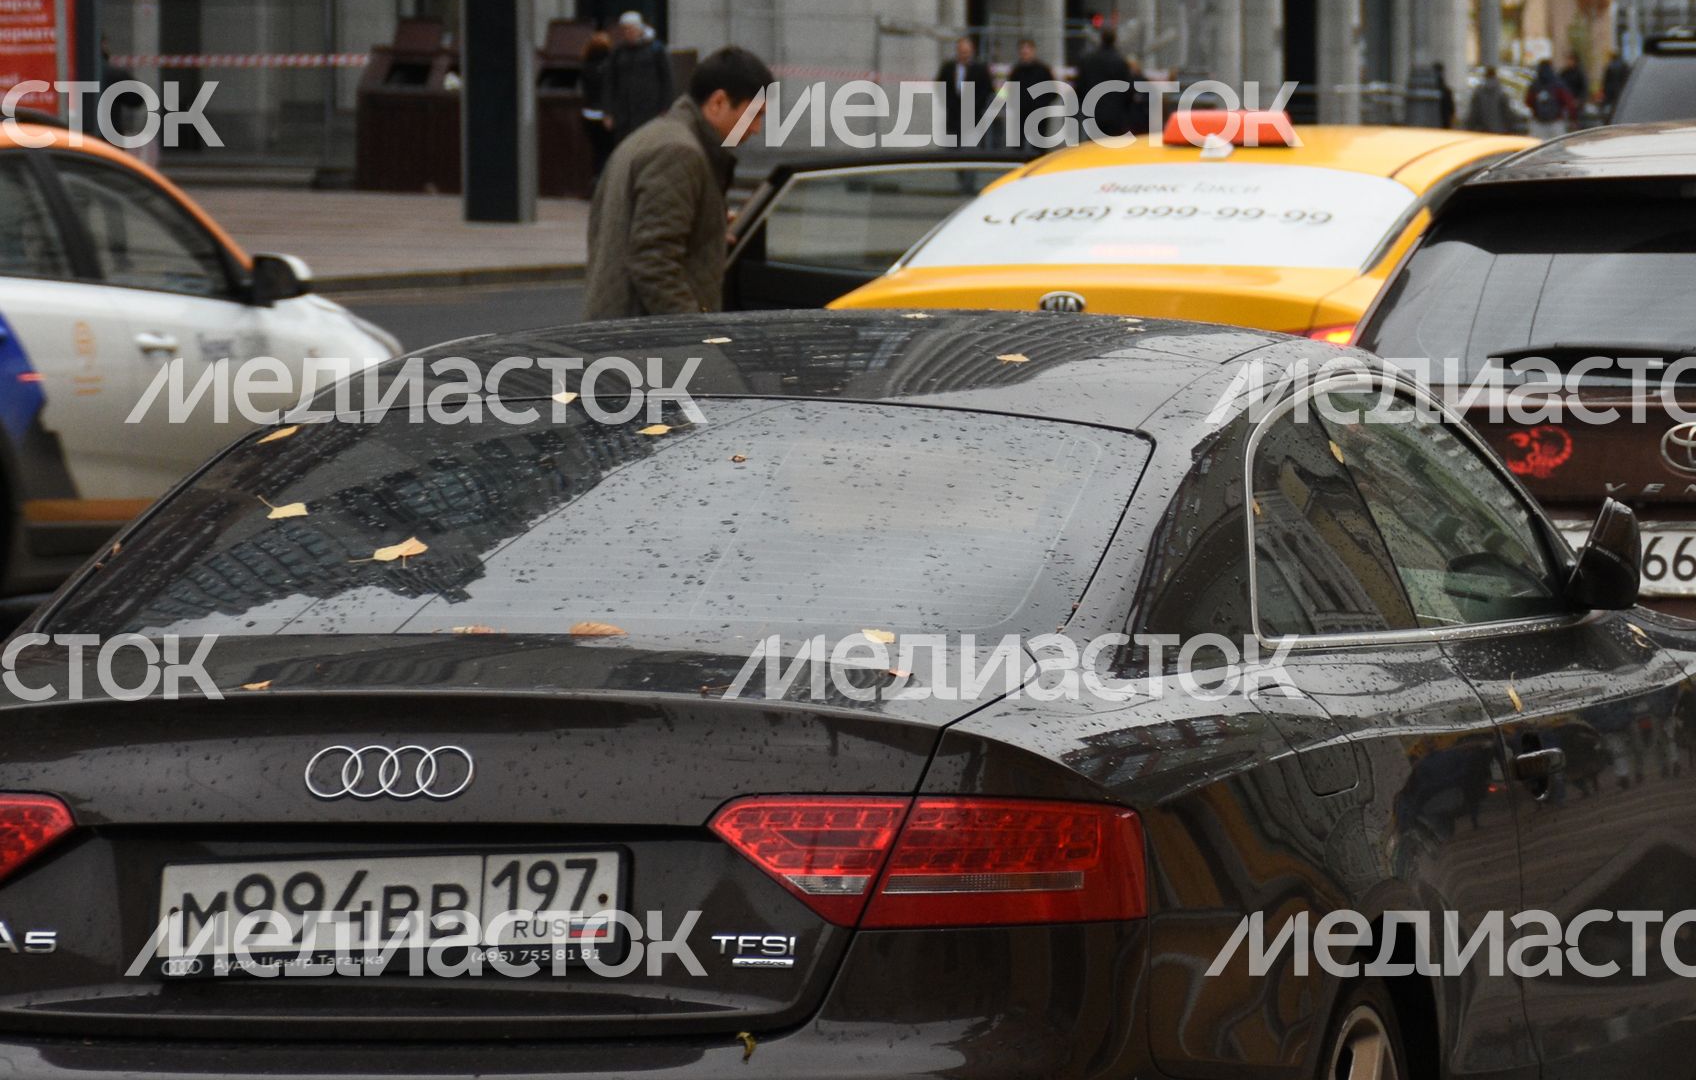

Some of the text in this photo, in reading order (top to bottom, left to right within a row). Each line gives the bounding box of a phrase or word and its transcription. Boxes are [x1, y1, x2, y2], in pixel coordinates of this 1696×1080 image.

[1011, 204, 1334, 227] (495) 999-99-99
[491, 858, 599, 915] 197
[513, 919, 566, 938] RUS
[520, 950, 550, 961] 755
[555, 949, 575, 960] 81
[711, 935, 797, 956] TFSI
[317, 954, 385, 966] Таганка
